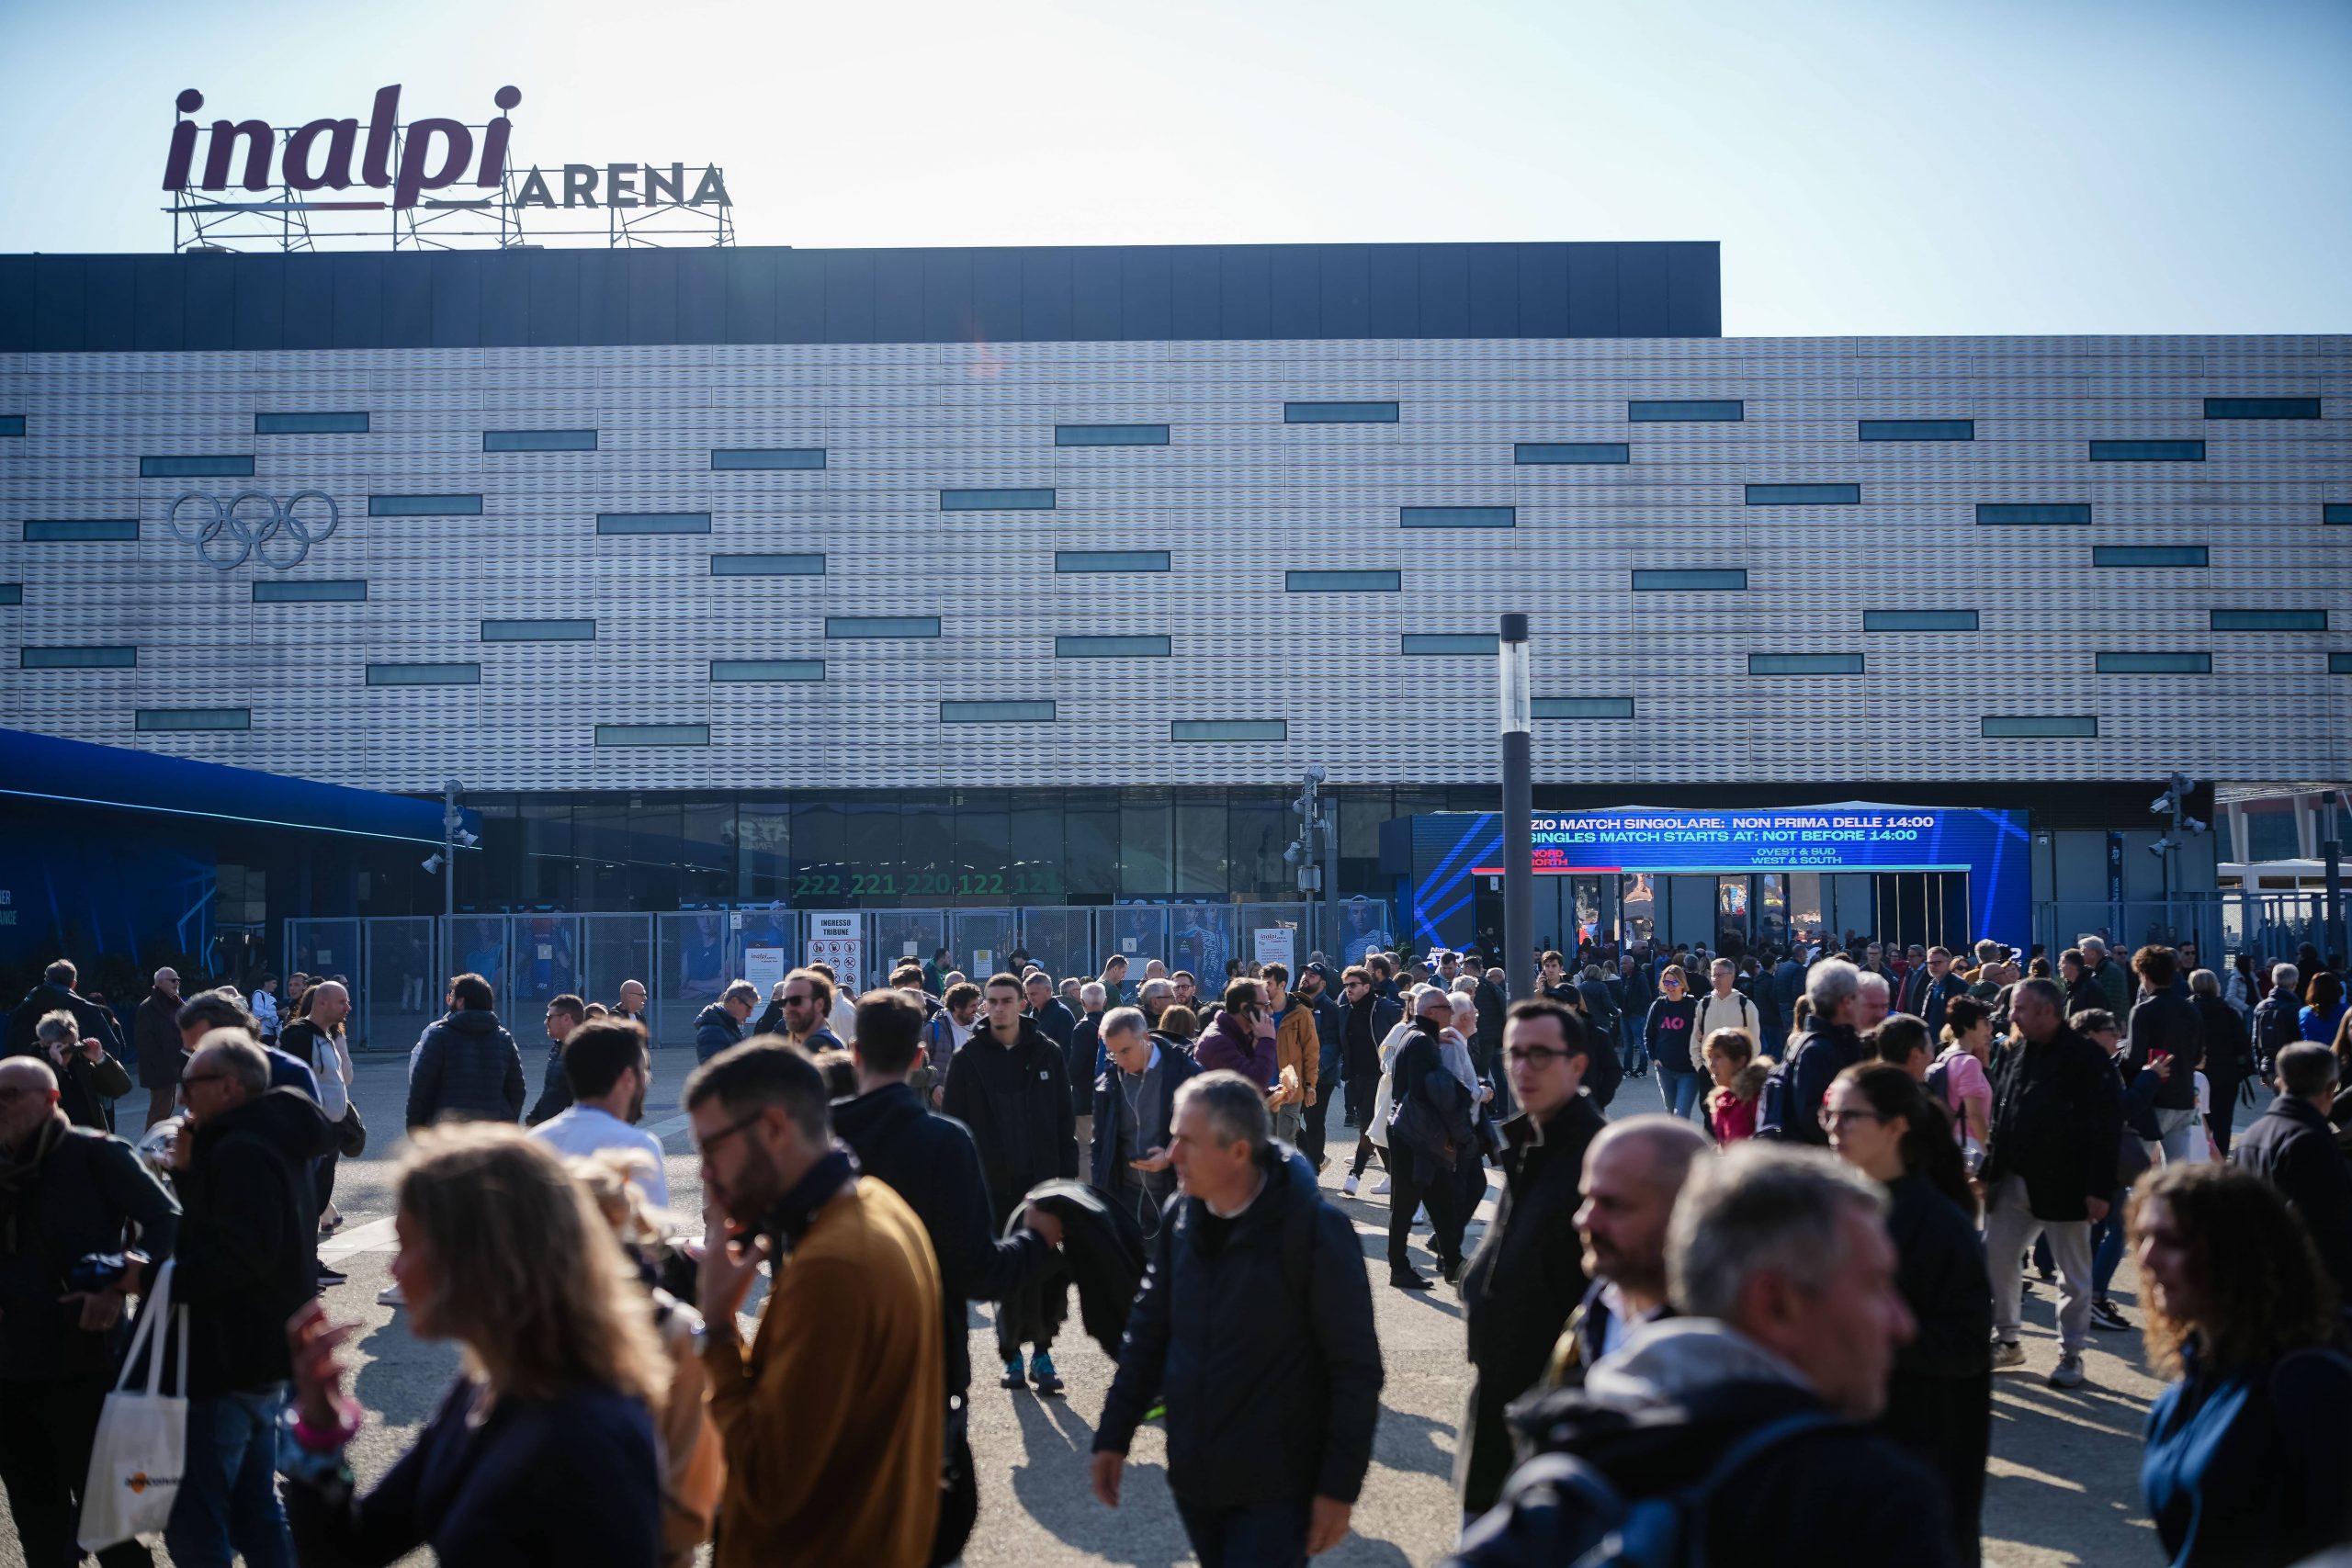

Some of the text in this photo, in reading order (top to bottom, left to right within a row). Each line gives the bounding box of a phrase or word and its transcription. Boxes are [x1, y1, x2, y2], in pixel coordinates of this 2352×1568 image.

[163, 84, 521, 210] inalpi
[514, 162, 733, 209] ARENA
[1560, 818, 1621, 829] MATCH
[1623, 818, 1725, 829] SINGOLARE:
[1733, 818, 1770, 829] NON
[1774, 817, 1829, 829] PRIMA
[1833, 817, 1883, 828] DELLE
[1887, 817, 1934, 828] 14:00
[1532, 829, 1917, 843] SINGLES MATCH STARTS AT: NOT BEFORE 14:00
[1757, 848, 1837, 856] OVEST & SUD
[1751, 856, 1842, 864] WEST & SOUTH
[796, 874, 841, 895] 222
[851, 874, 897, 895] 221
[906, 874, 951, 895] 220
[958, 874, 1004, 895] 122
[0, 889, 11, 905] ER
